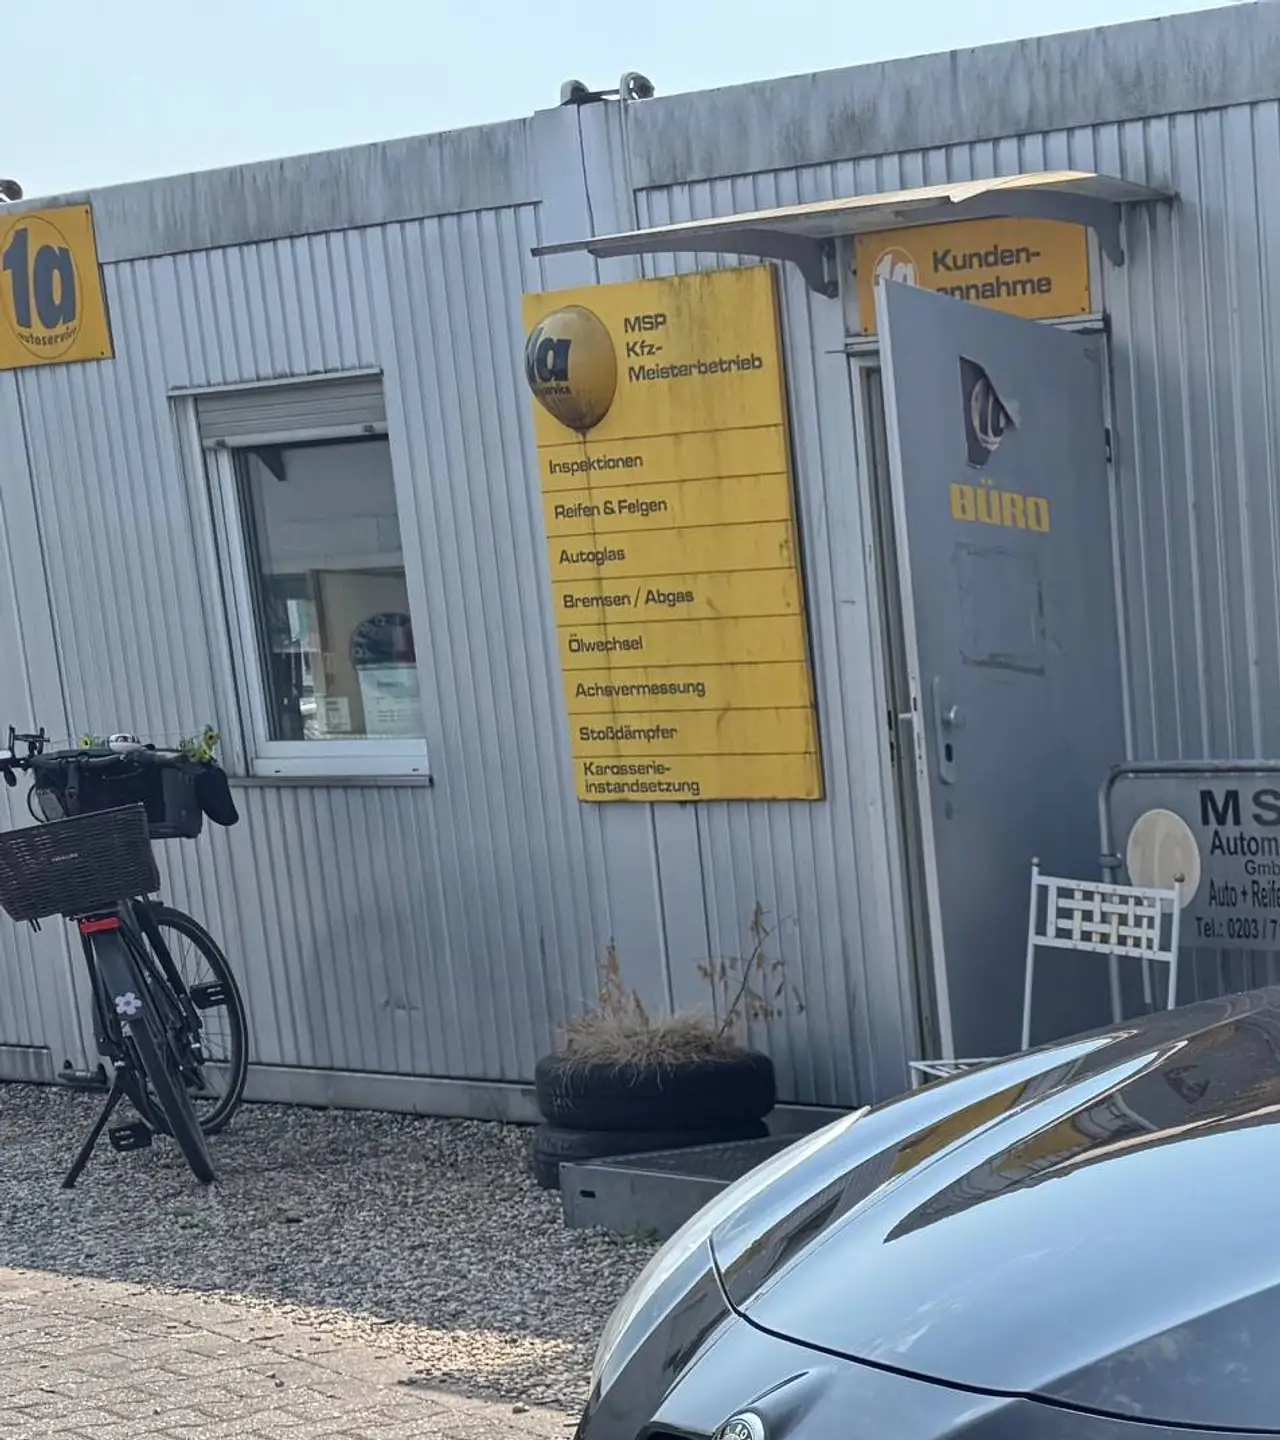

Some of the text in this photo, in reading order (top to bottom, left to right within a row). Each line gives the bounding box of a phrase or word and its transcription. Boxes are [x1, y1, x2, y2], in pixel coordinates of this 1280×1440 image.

[932, 244, 1041, 273] Kunden-
[3, 227, 77, 329] 1a
[624, 313, 667, 333] MSP
[626, 341, 663, 357] Kfz-
[628, 353, 763, 382] Meisterbetrieb
[549, 455, 644, 476] Inspektionen
[554, 498, 668, 519] Reifen & Felgen
[950, 477, 1050, 533] BÜRO
[559, 547, 626, 566] Autoglas
[563, 586, 694, 609] Bremsen / Abgas
[568, 633, 643, 653] Ölwechsel
[575, 680, 706, 698] Achsvermessung
[579, 725, 678, 743] Stoßdämpfer
[583, 761, 671, 776] Karosserie-
[585, 778, 700, 796] instandsetzung
[1208, 878, 1238, 906] Auto
[1241, 884, 1249, 903] +
[1227, 918, 1259, 939] 0203
